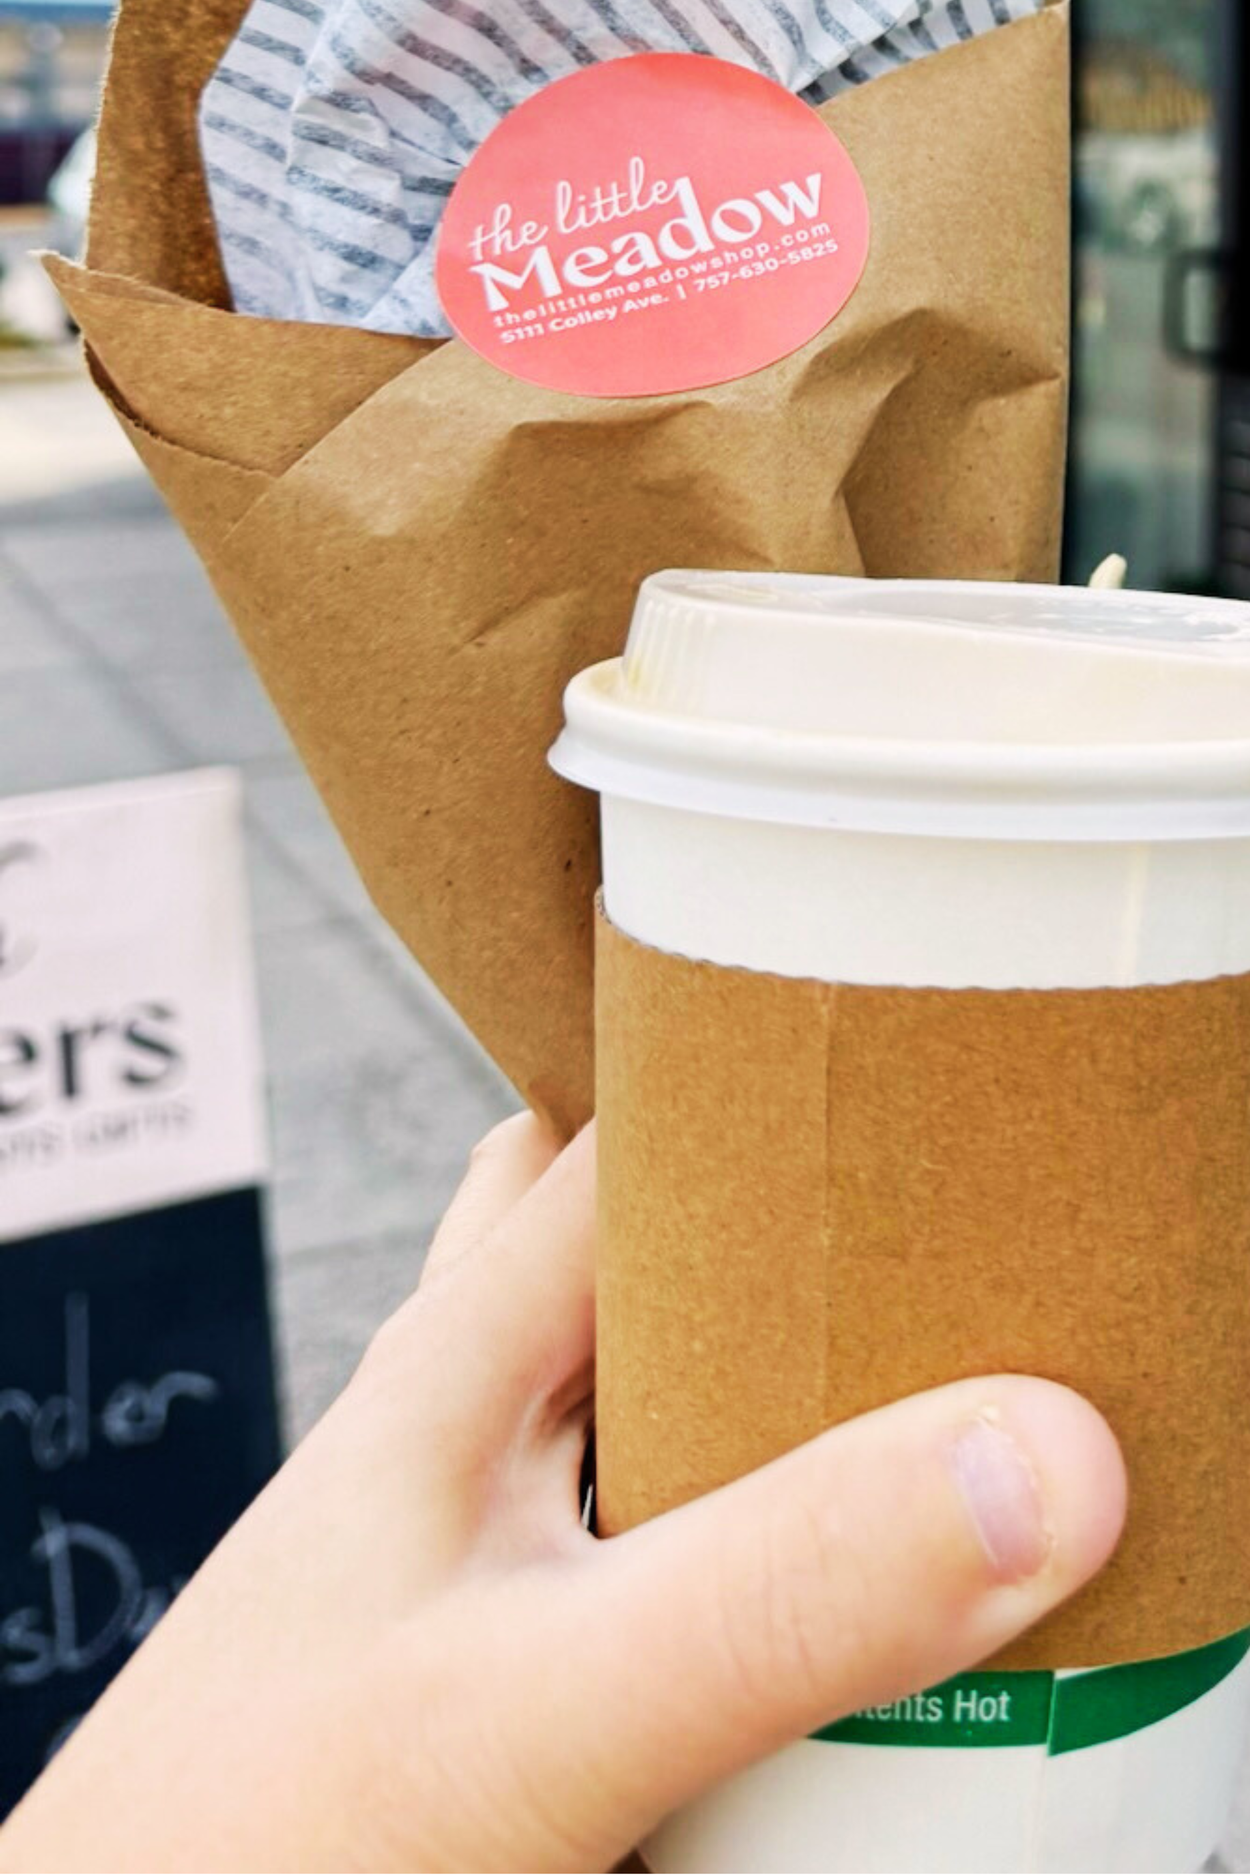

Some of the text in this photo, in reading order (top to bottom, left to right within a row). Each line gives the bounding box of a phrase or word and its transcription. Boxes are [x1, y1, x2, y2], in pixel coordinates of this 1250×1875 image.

[467, 156, 679, 261] the little
[468, 172, 822, 312] Meadow
[492, 222, 831, 328] thelittlemeadowshop.com
[499, 323, 545, 344] 5111
[548, 306, 617, 331] Colley
[622, 292, 670, 314] Ave.
[693, 238, 839, 292] 757-630-5825
[952, 1688, 1012, 1723] Hot
